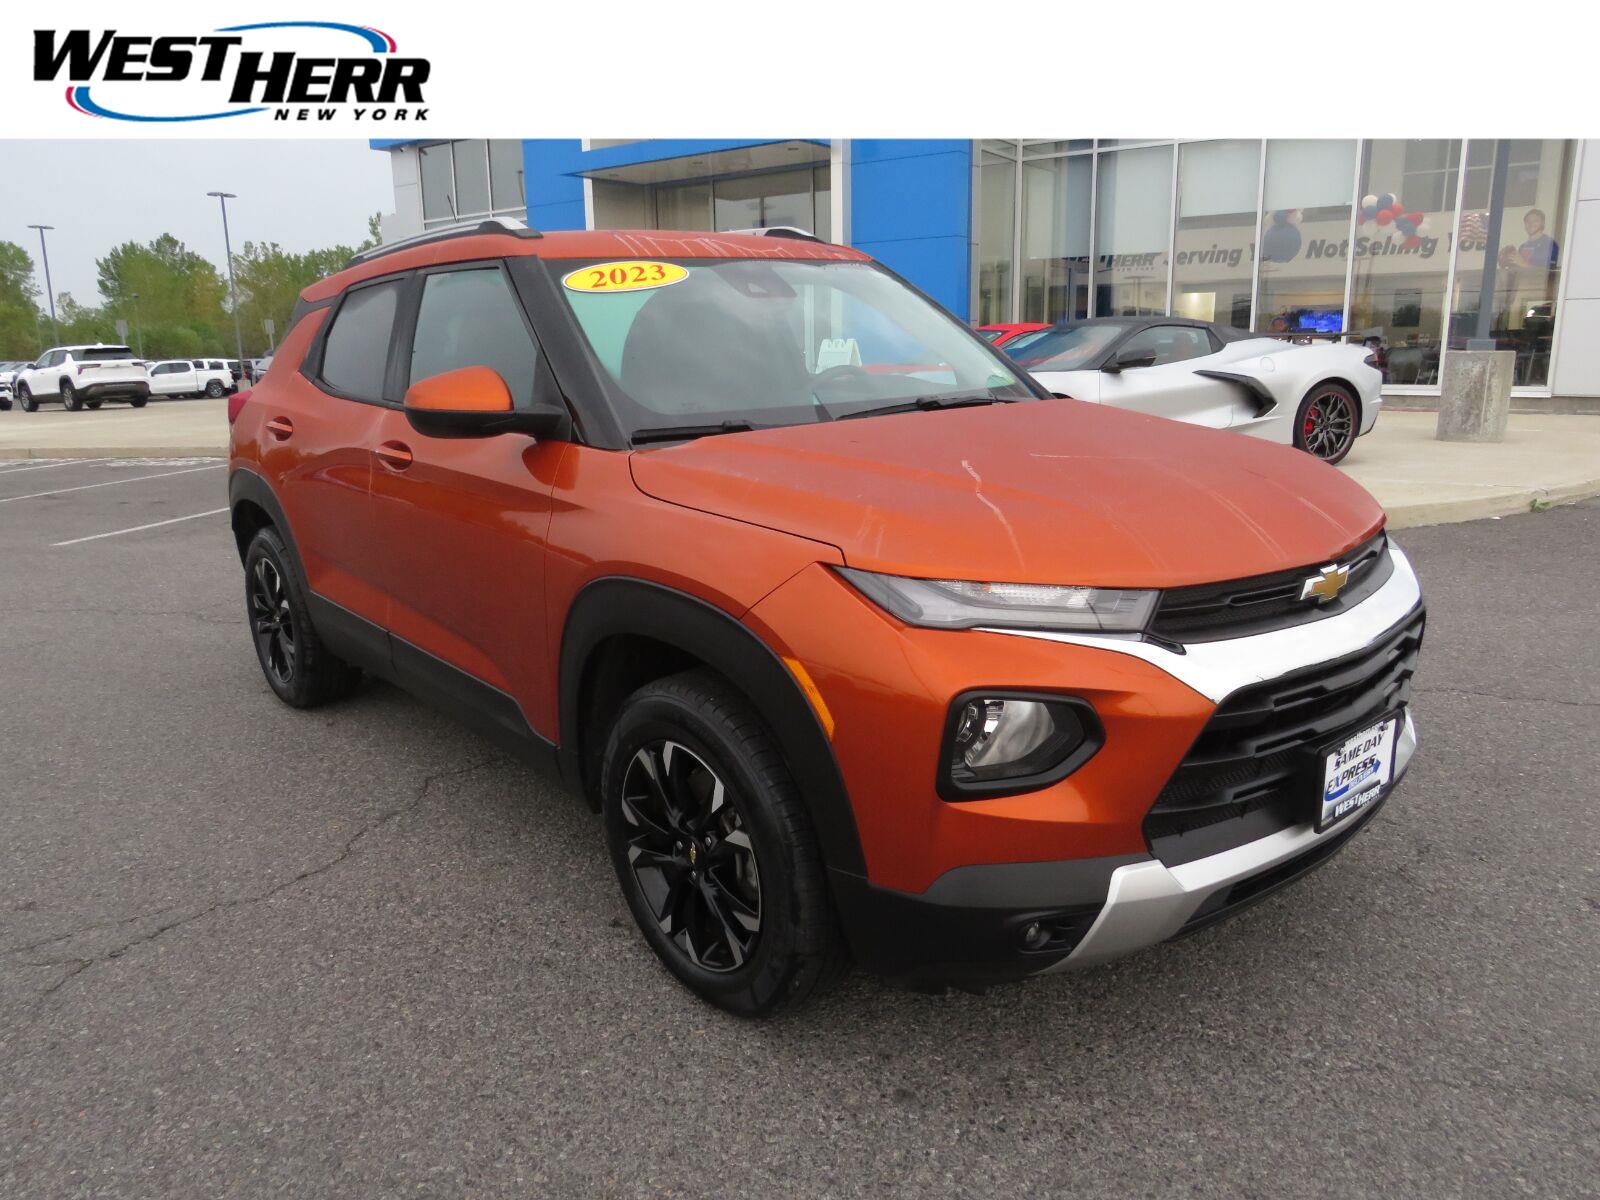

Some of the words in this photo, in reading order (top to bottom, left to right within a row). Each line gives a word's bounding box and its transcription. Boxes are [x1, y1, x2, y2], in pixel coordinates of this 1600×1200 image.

[1305, 239, 1350, 259] Not
[589, 264, 667, 288] 2023
[1362, 731, 1386, 753] DAY
[1326, 754, 1377, 793] EXPRESS
